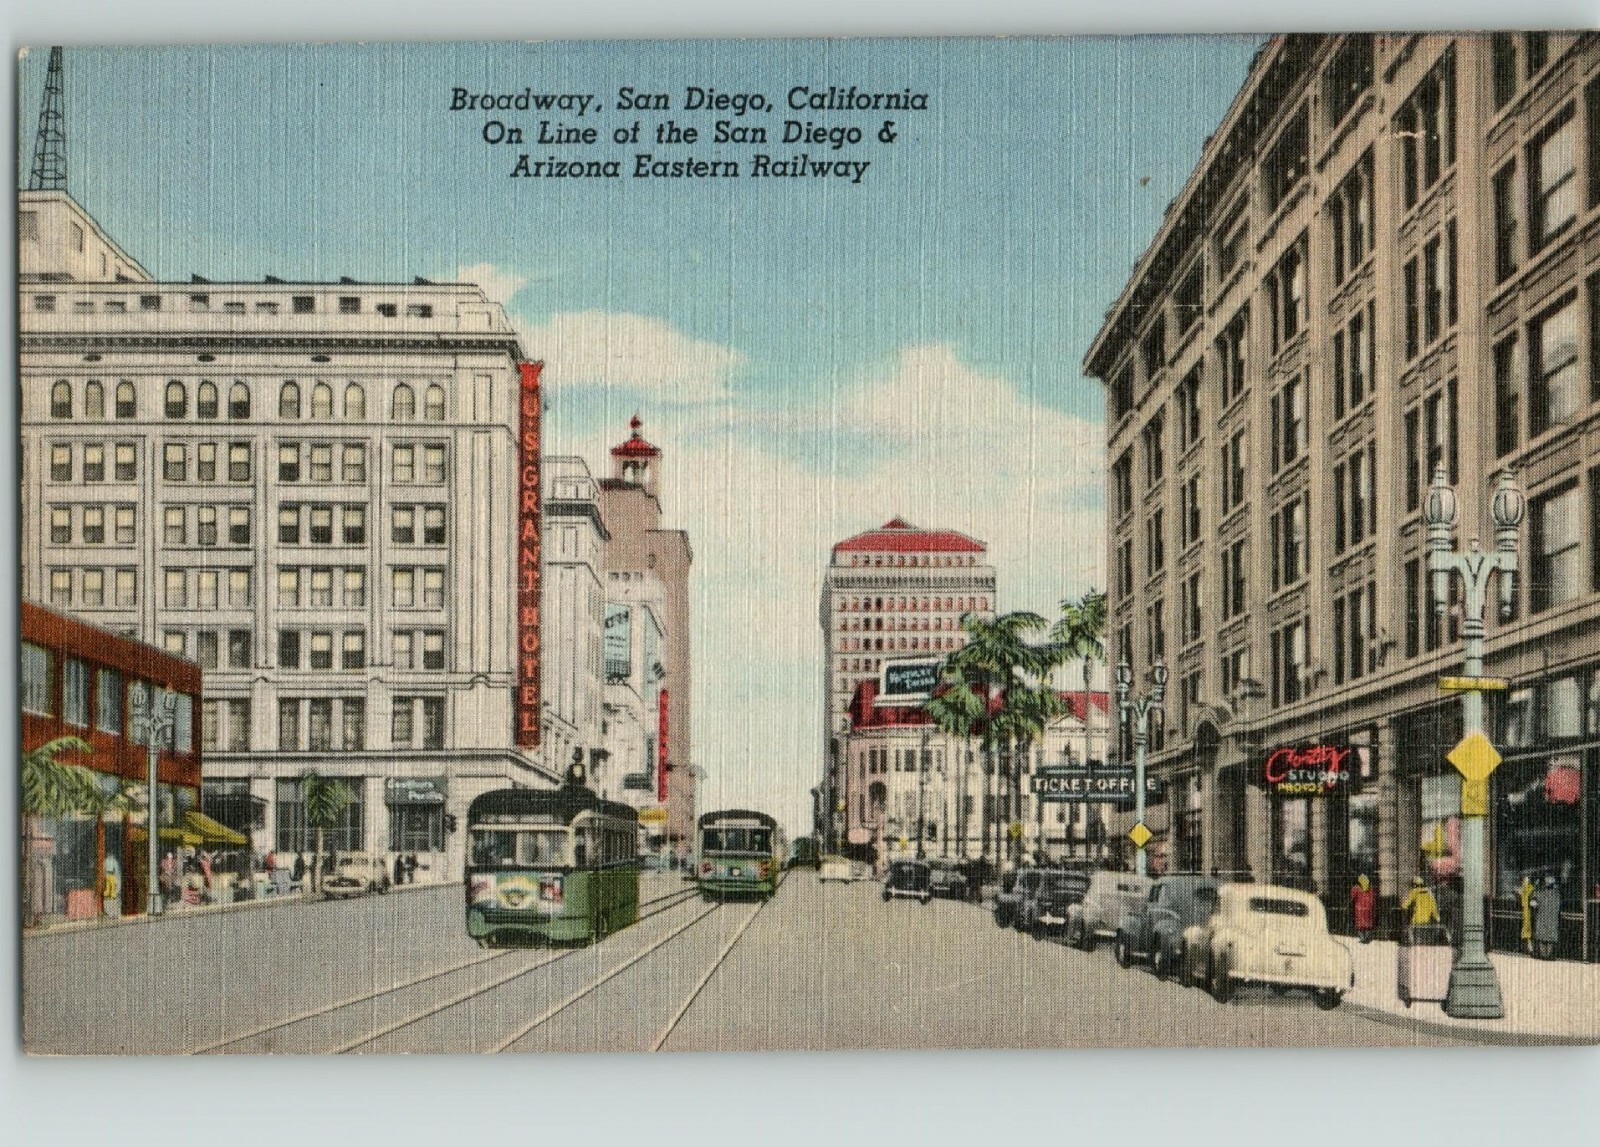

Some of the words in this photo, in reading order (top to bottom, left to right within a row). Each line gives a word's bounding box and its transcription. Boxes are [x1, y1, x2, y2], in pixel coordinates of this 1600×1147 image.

[522, 606, 538, 731] HOTEL
[1033, 778, 1092, 792] TICKET
[1097, 778, 1157, 792] OFFIE
